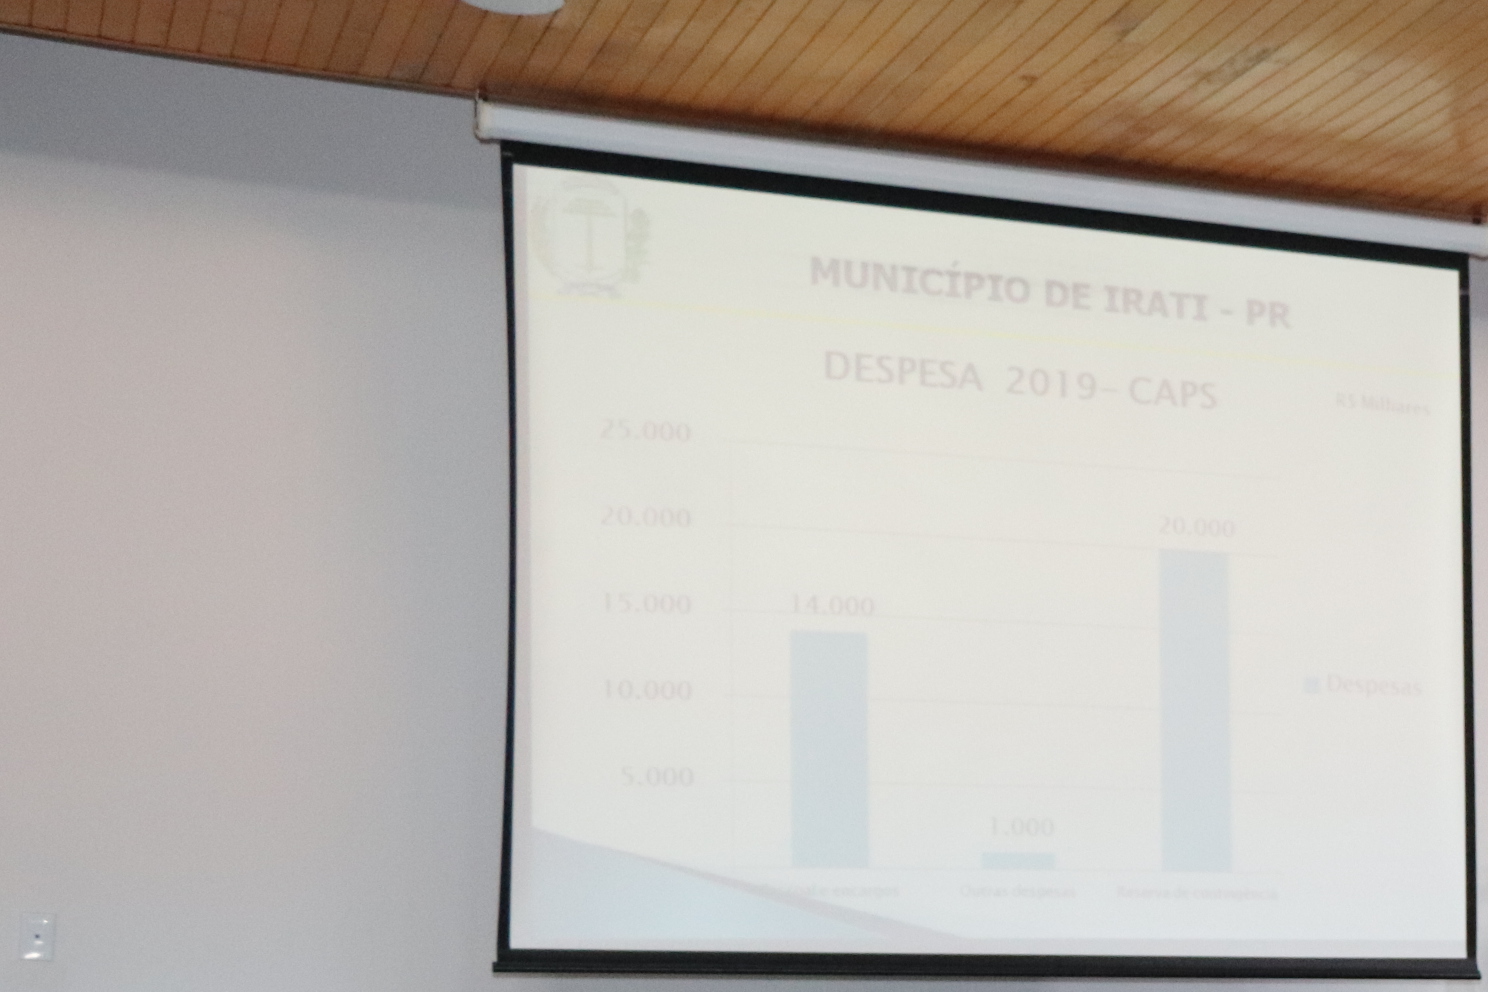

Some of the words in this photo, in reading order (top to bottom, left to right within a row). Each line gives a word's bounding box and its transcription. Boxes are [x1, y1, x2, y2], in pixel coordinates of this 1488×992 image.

[809, 256, 1031, 305] MUNICÍPIO
[1044, 279, 1092, 311] DE
[1103, 285, 1209, 322] IRATI
[1245, 298, 1293, 329] PR
[823, 350, 984, 392] DESPESA
[1128, 376, 1219, 411] CAPS
[600, 418, 692, 442] 25.000
[600, 505, 692, 528] 20.000
[1158, 515, 1236, 538] 20.000
[603, 592, 692, 615] 15.000
[791, 592, 875, 617] 14.000
[603, 679, 692, 701] 10.000
[1326, 672, 1423, 699] Despesas
[621, 765, 695, 787] 5.000
[990, 815, 1056, 837] 1.000
